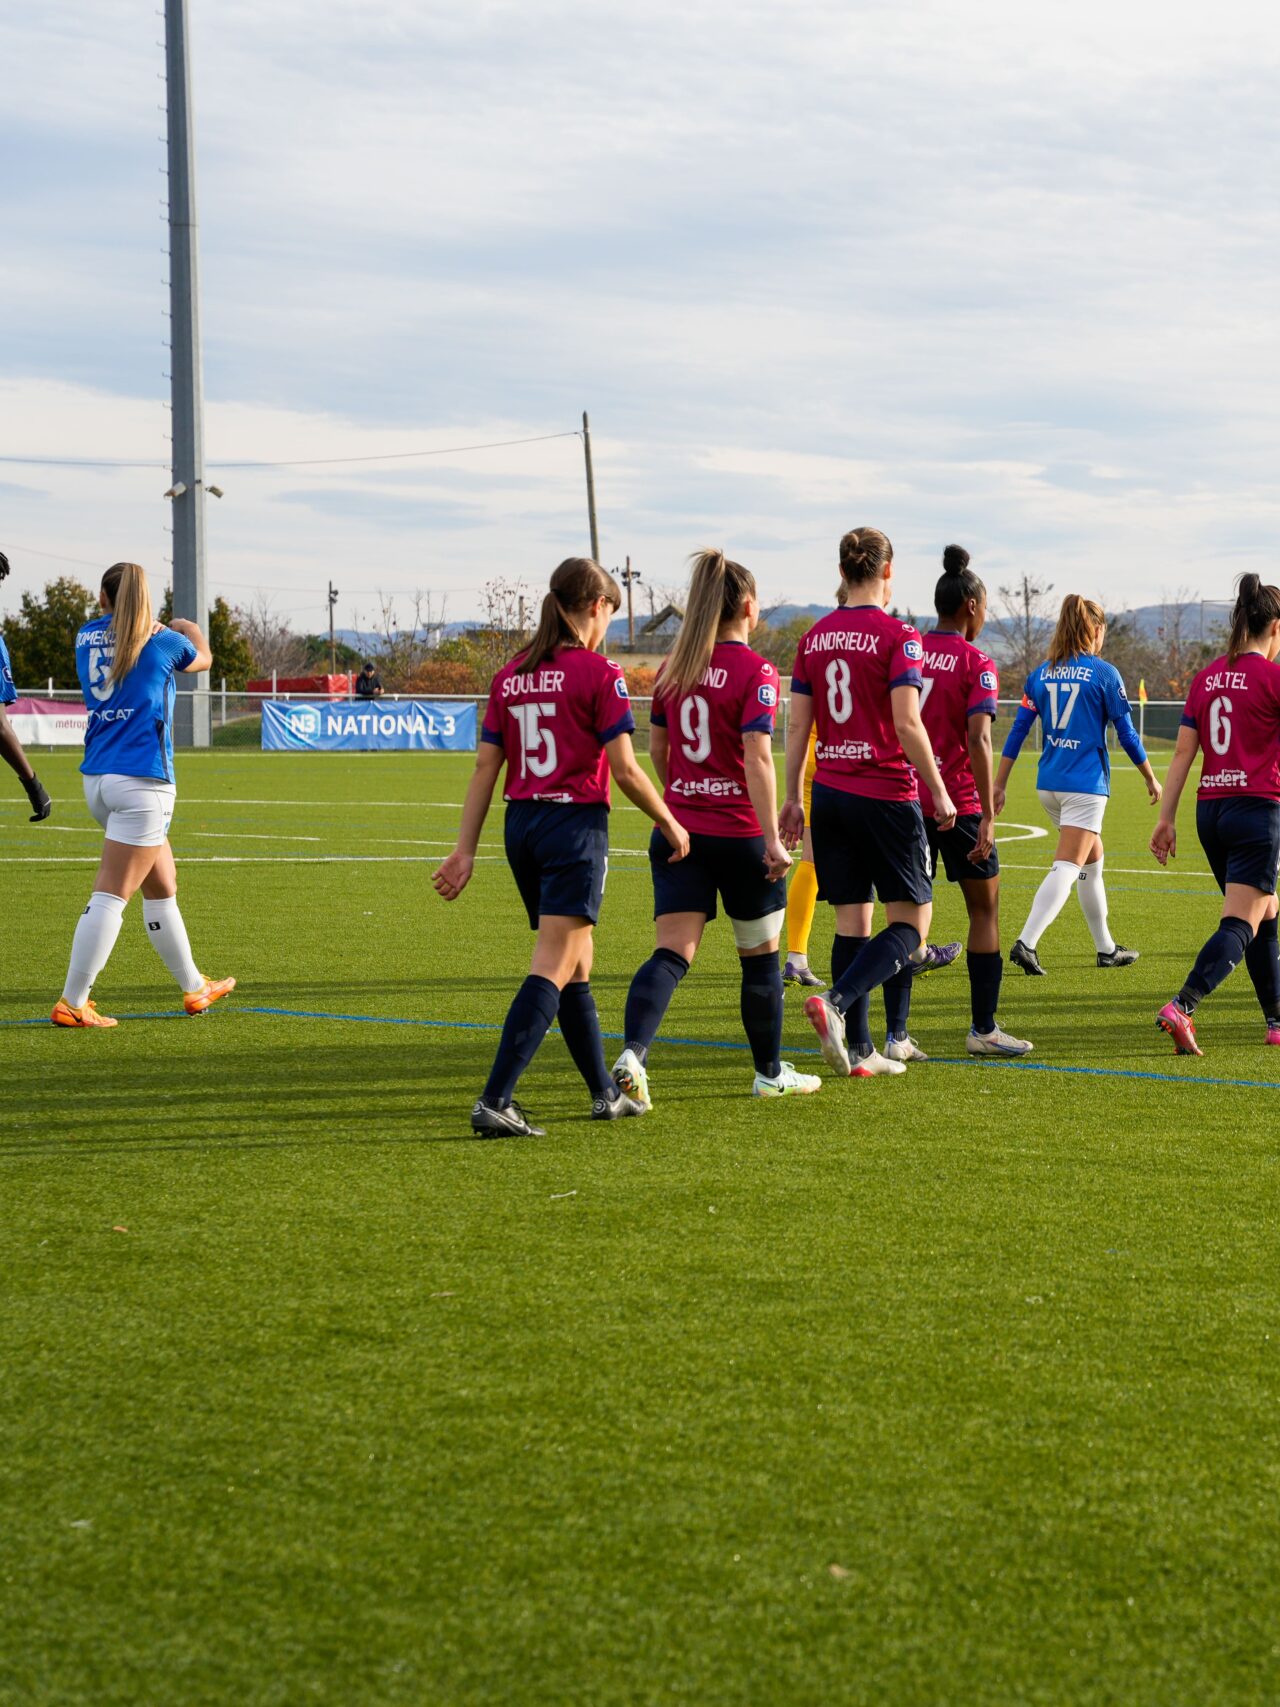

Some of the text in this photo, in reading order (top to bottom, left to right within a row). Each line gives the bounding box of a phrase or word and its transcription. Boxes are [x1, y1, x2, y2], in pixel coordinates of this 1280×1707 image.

[804, 632, 880, 654] LANDRIEUX
[88, 646, 116, 702] 5
[501, 670, 566, 698] SOULIER
[825, 658, 853, 724] 8
[1040, 666, 1093, 682] LARRIVEE
[1205, 671, 1248, 692] SALTEL
[327, 714, 456, 737] NATIONAL 3
[680, 694, 711, 764] 9
[1045, 682, 1080, 729] 17
[1209, 695, 1233, 756] 6
[507, 702, 558, 780] 15
